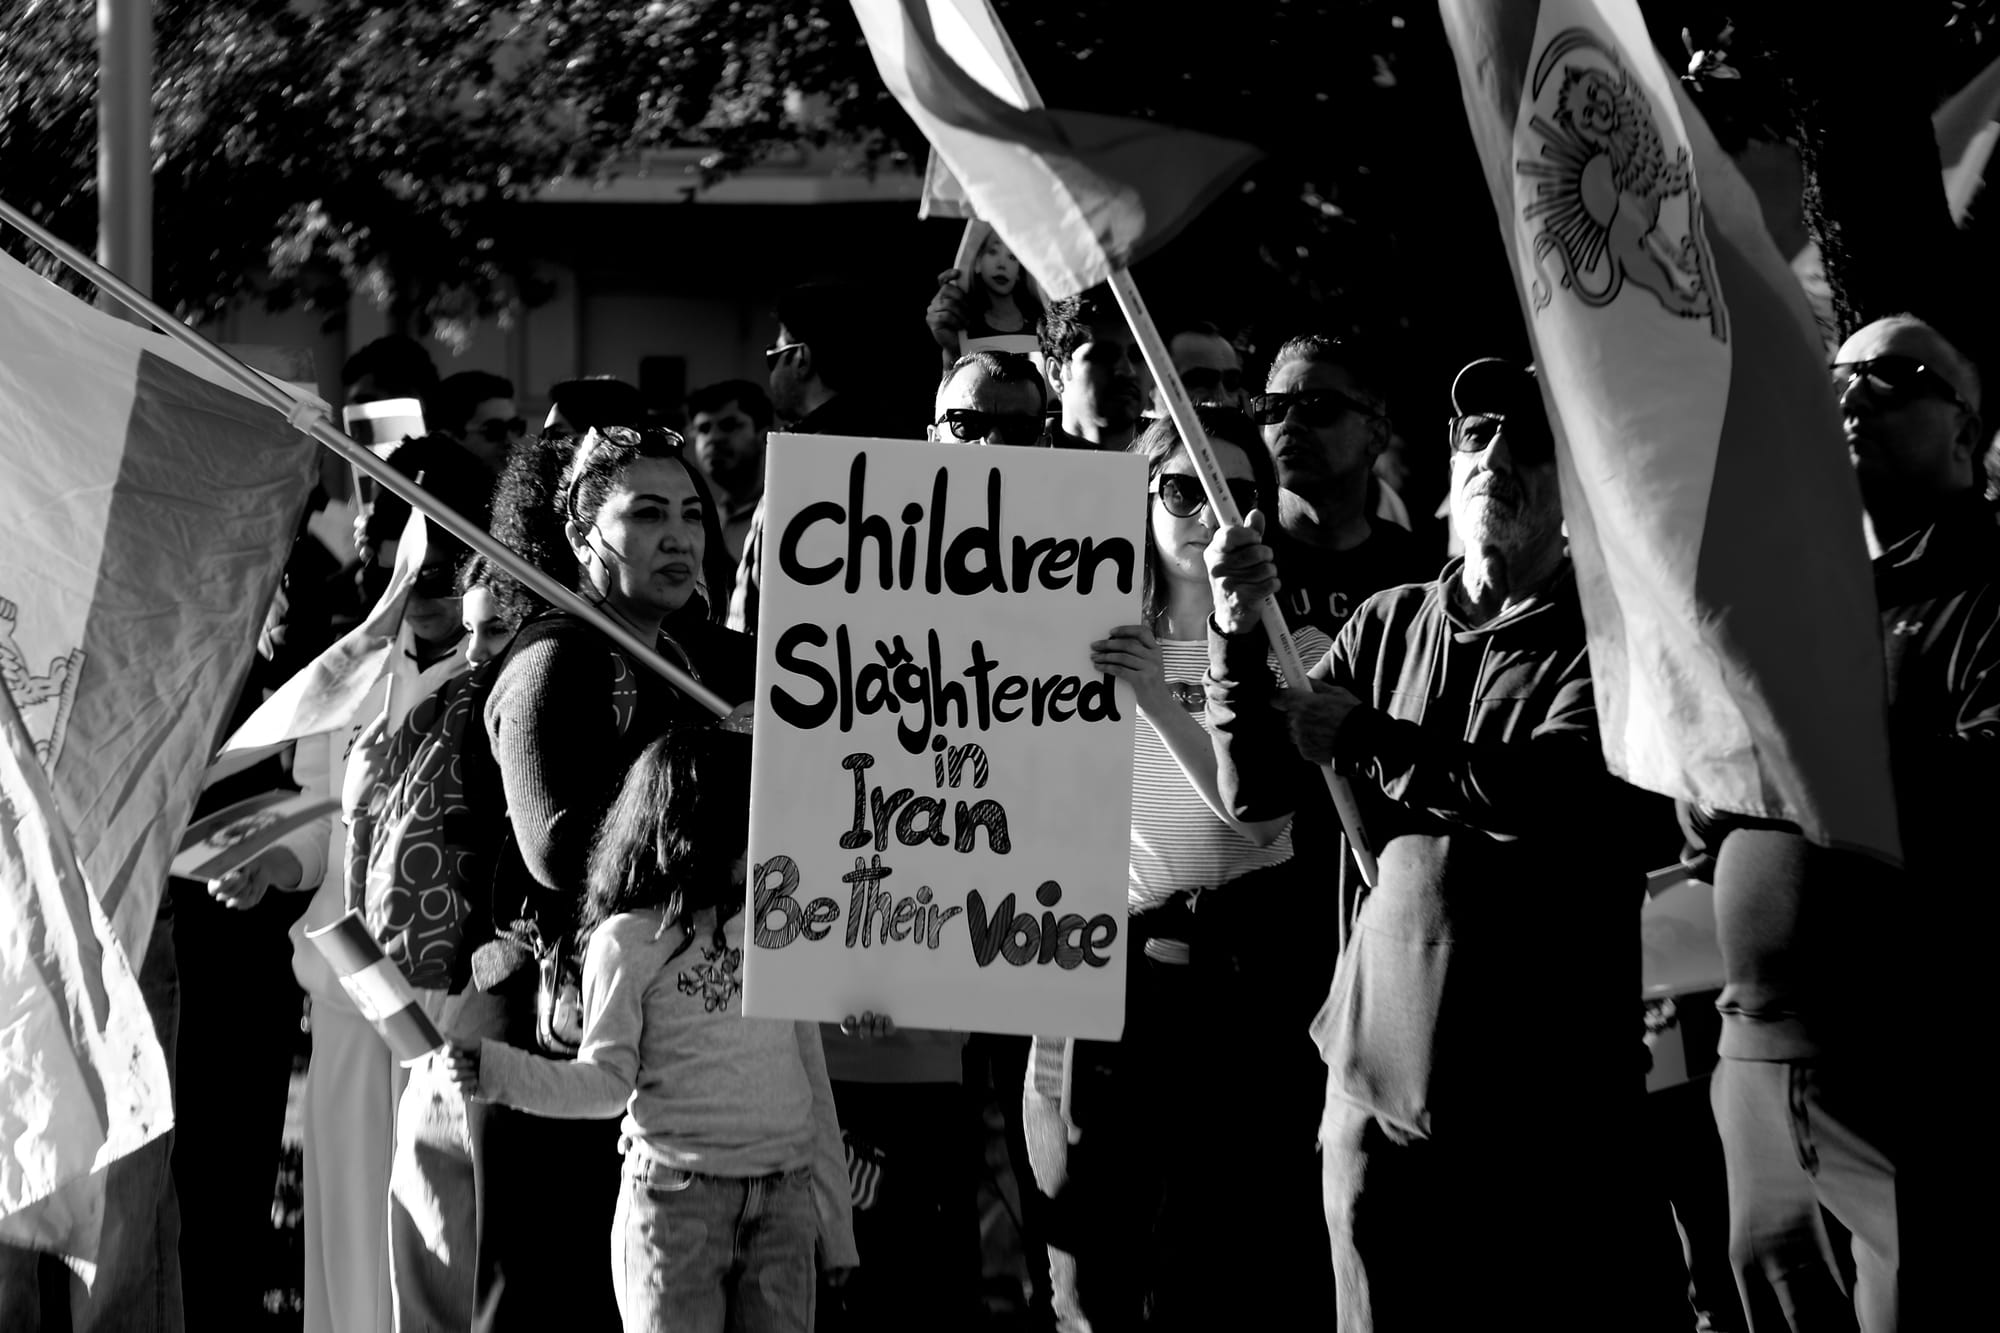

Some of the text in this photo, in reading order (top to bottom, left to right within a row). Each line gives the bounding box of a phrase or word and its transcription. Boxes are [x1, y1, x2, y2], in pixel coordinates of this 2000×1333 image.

[839, 753, 1011, 855] Iran
[931, 734, 989, 788] in
[753, 855, 840, 949] Be
